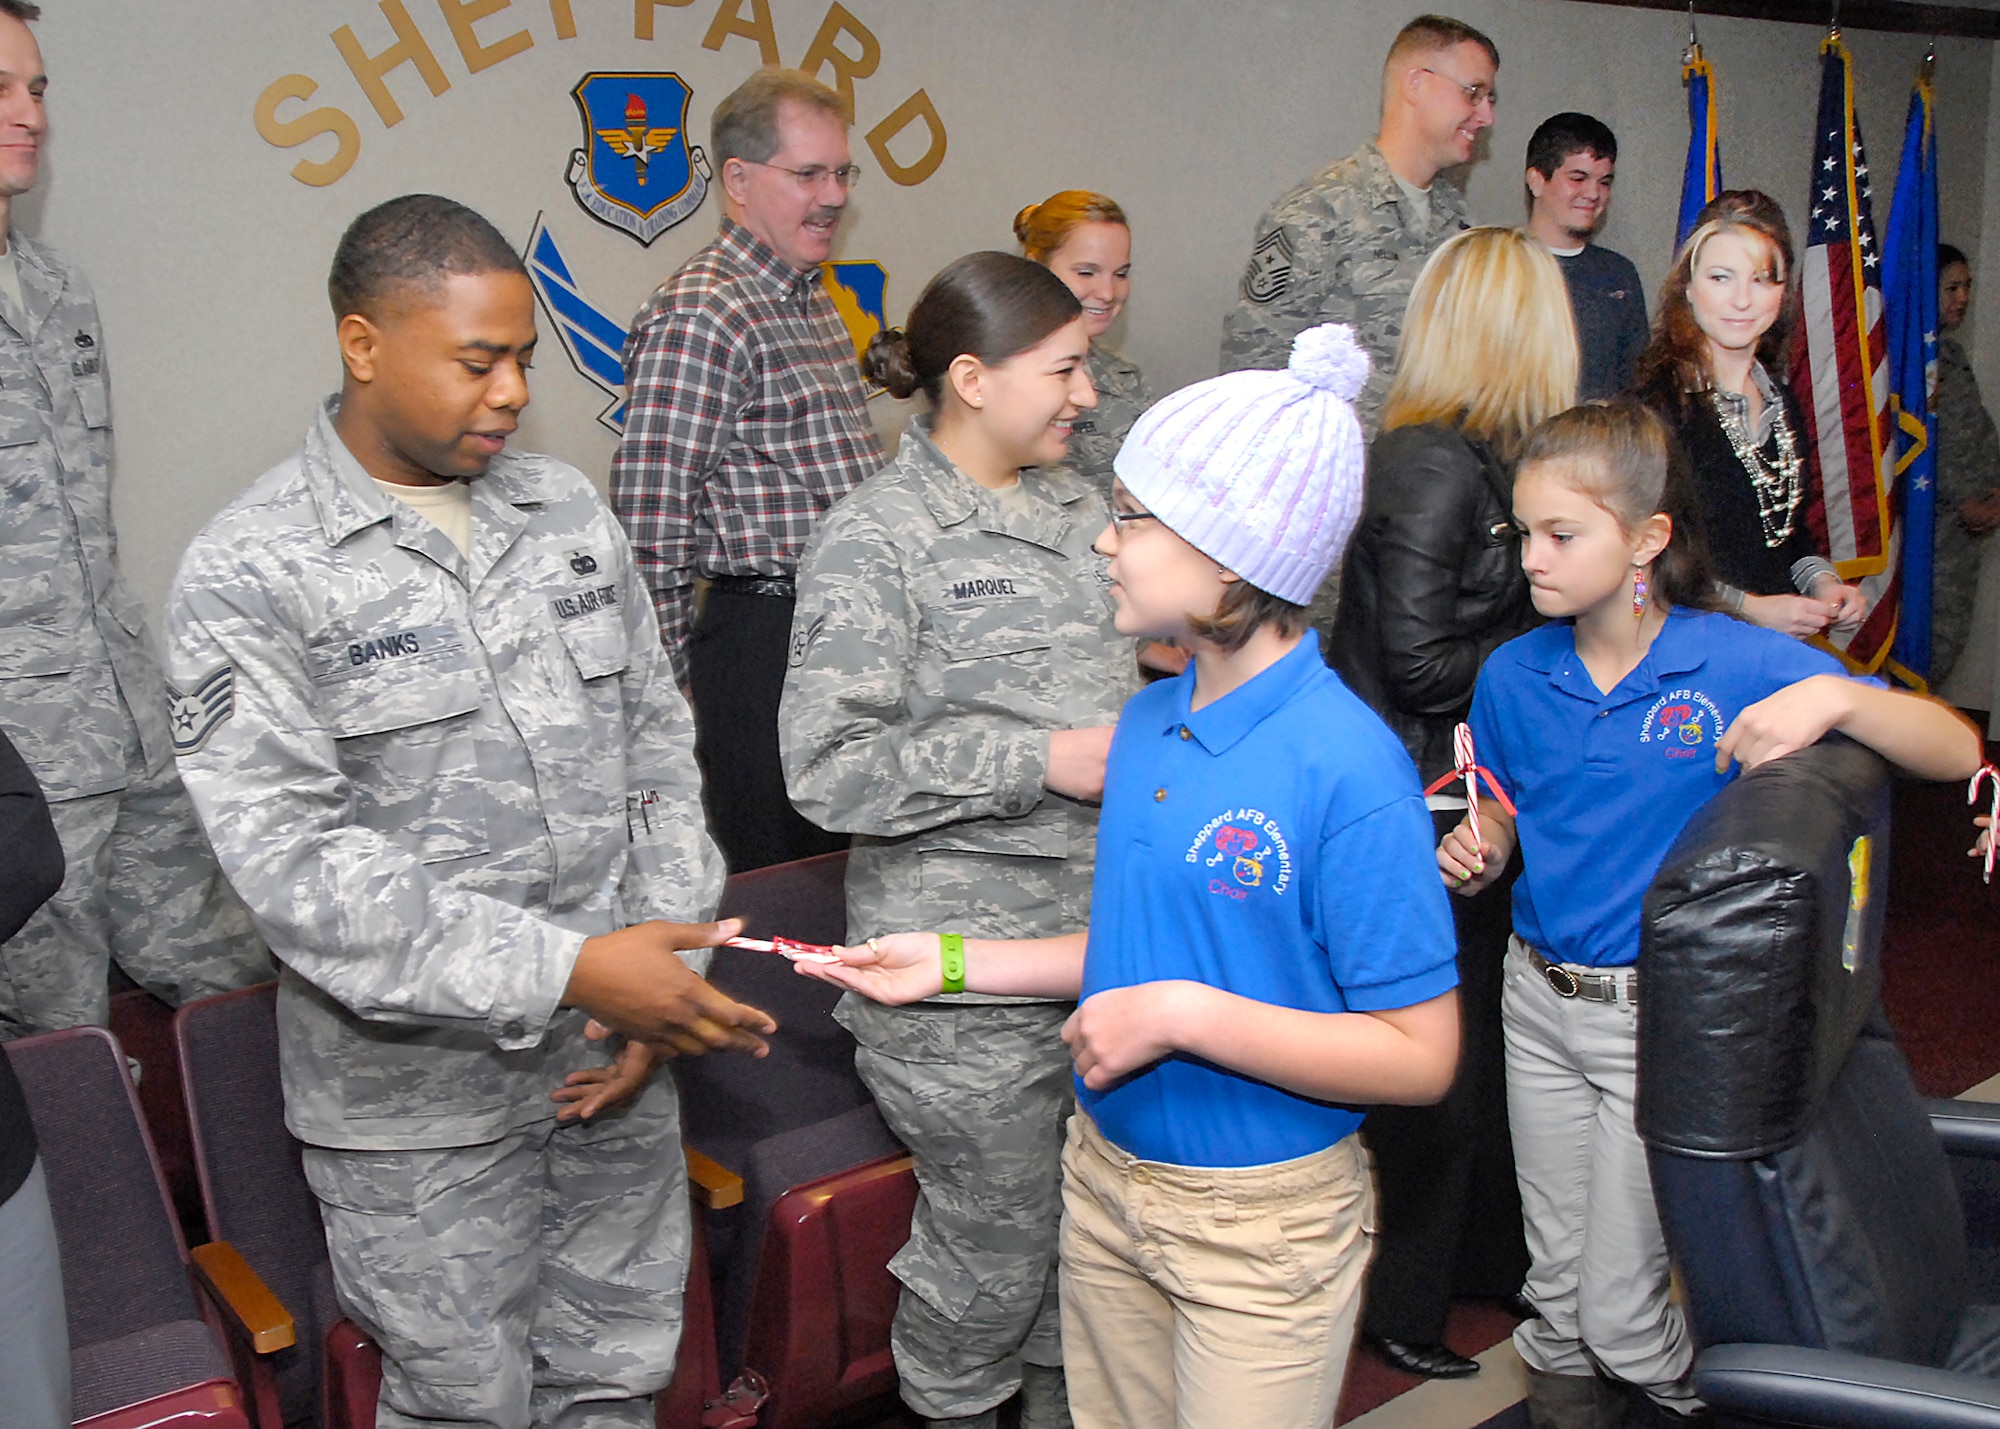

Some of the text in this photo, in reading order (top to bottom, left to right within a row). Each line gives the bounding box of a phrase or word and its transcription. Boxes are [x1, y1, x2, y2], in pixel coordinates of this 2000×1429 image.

[253, 0, 948, 187] SHEARD
[577, 591, 601, 614] AIR
[953, 578, 1017, 600] MARQUEZ
[348, 631, 420, 667] BANKS
[1639, 695, 1668, 744] Sheppard
[1668, 689, 1691, 702] AFB
[1664, 746, 1698, 760] Choir
[1184, 808, 1293, 896] Sheppard AFB Elementary
[1208, 878, 1249, 901] Choir
